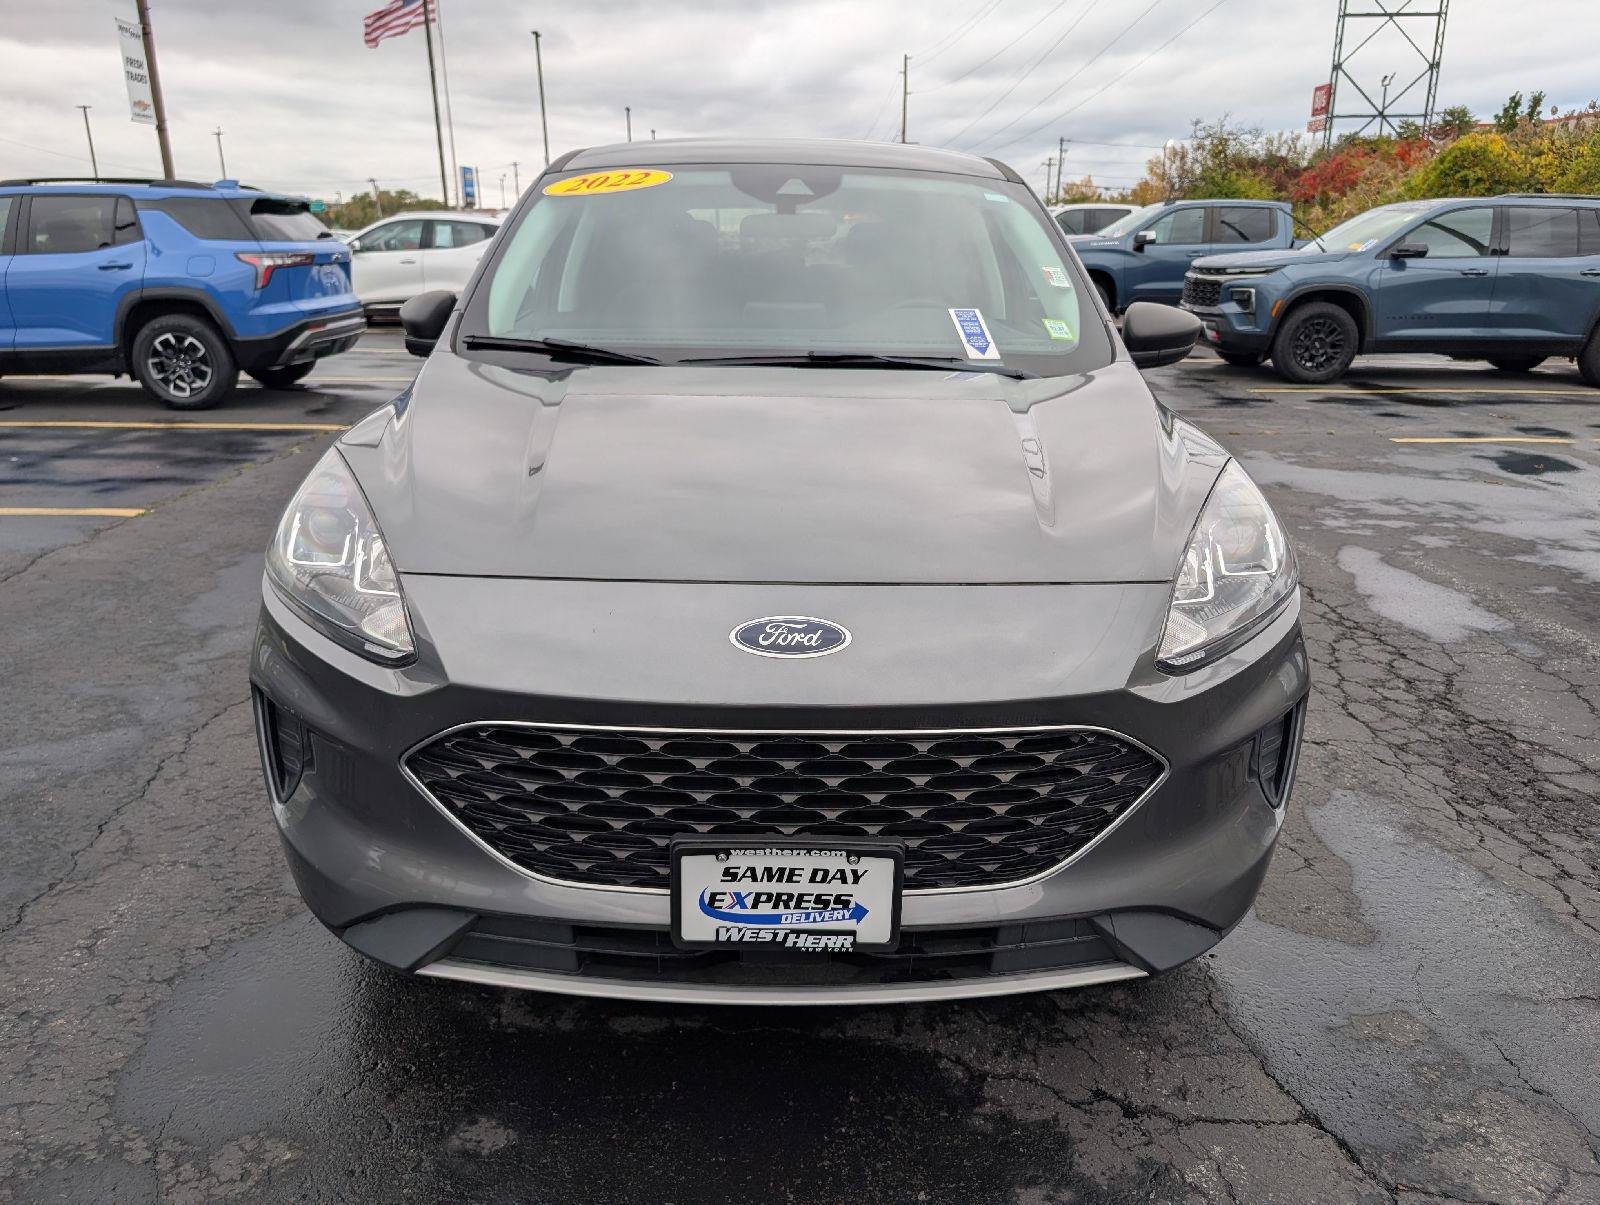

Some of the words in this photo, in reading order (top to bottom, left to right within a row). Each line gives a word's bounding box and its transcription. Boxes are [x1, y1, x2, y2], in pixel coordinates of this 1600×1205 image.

[563, 172, 651, 192] 2022
[759, 622, 823, 646] Ford
[730, 849, 847, 857] westherr.com
[720, 866, 805, 883] SAME
[808, 867, 870, 885] DAY
[707, 891, 854, 911] EXPRESS
[780, 908, 854, 924] DELIVERY
